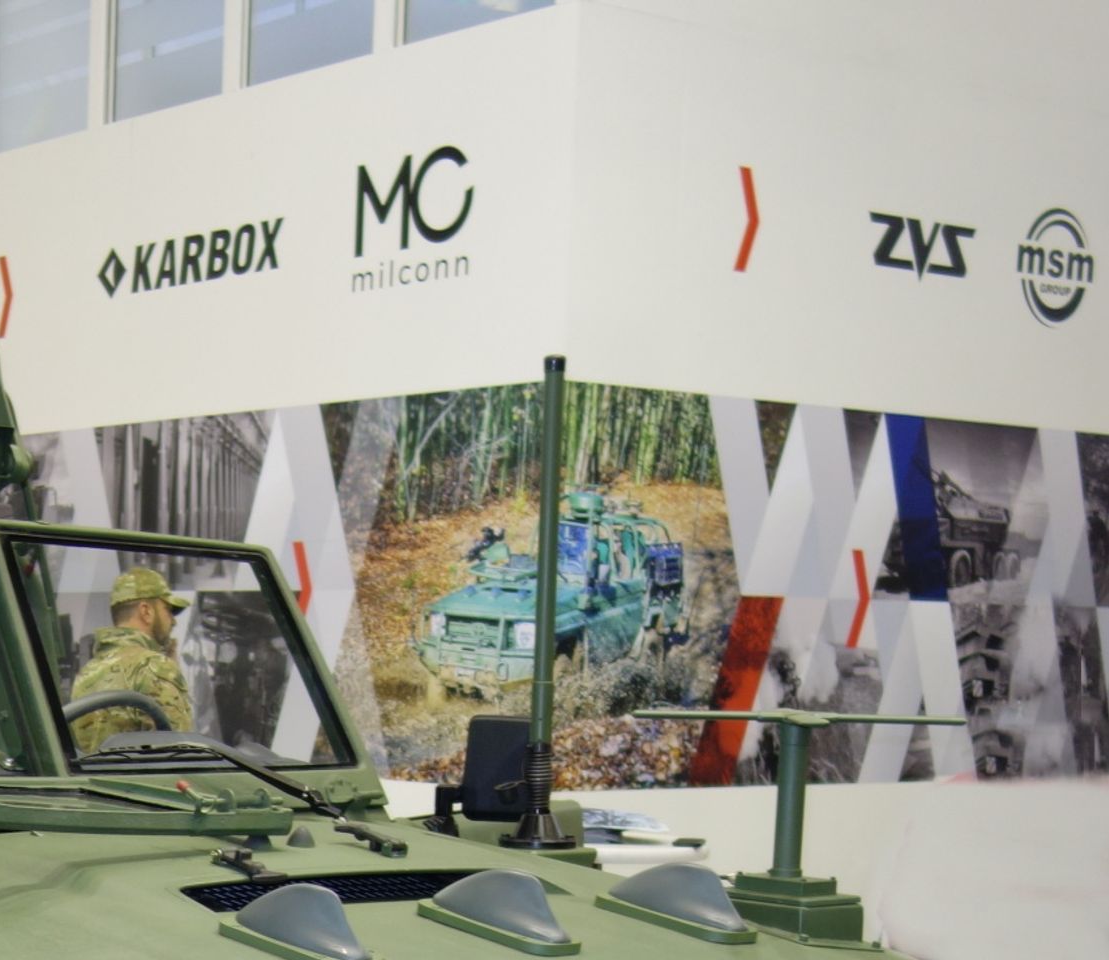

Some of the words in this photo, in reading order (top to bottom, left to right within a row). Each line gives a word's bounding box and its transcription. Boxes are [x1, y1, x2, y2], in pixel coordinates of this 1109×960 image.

[354, 145, 475, 258] MC
[131, 217, 284, 293] KARBOX
[351, 256, 469, 293] milconn
[869, 211, 976, 283] ZVS
[1017, 244, 1094, 284] msm
[1040, 283, 1071, 296] GROUP
